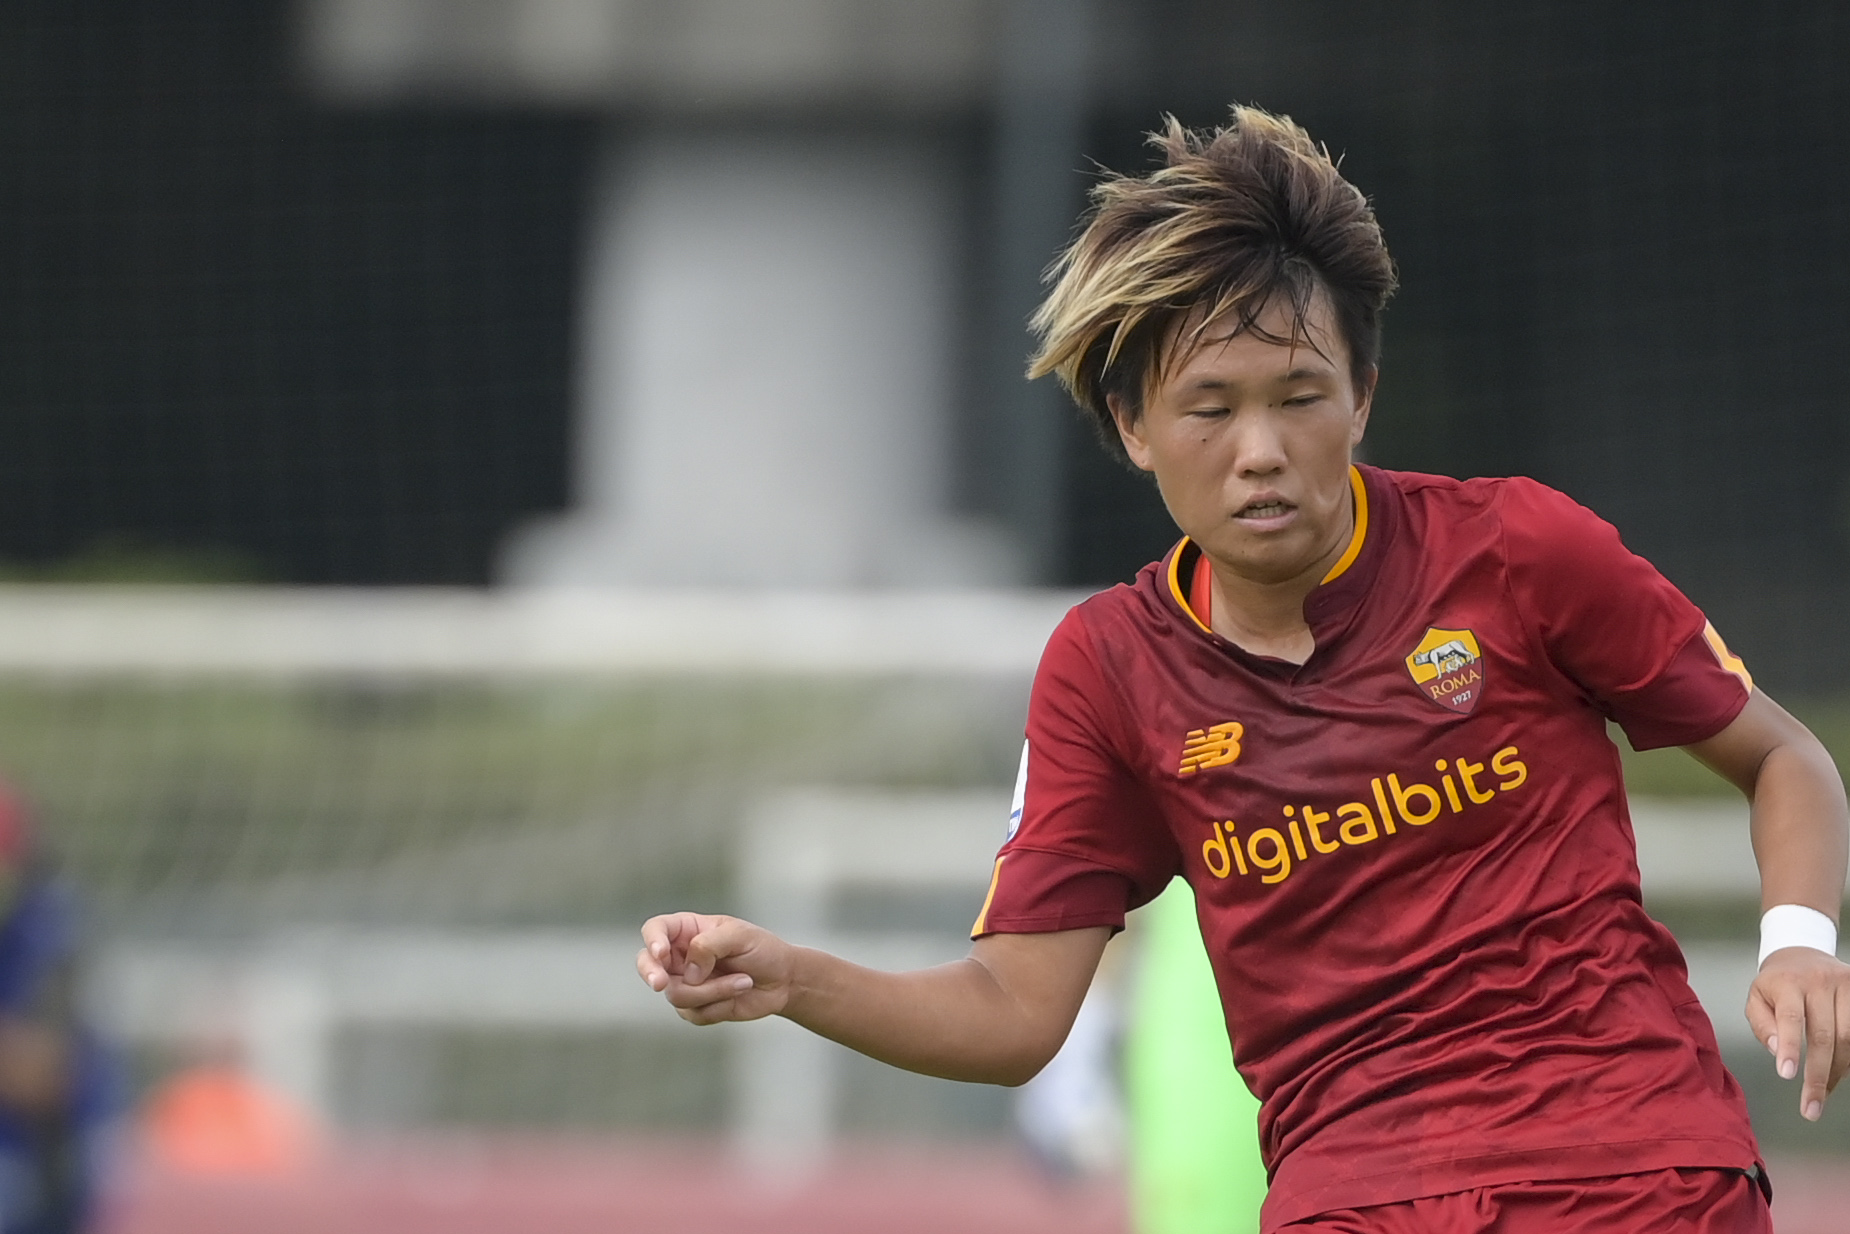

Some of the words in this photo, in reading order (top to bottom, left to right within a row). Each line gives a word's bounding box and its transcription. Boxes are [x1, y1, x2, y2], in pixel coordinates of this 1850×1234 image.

[1429, 669, 1481, 700] ROMA
[1452, 690, 1472, 706] 1927
[1202, 746, 1527, 884] digitalbits
